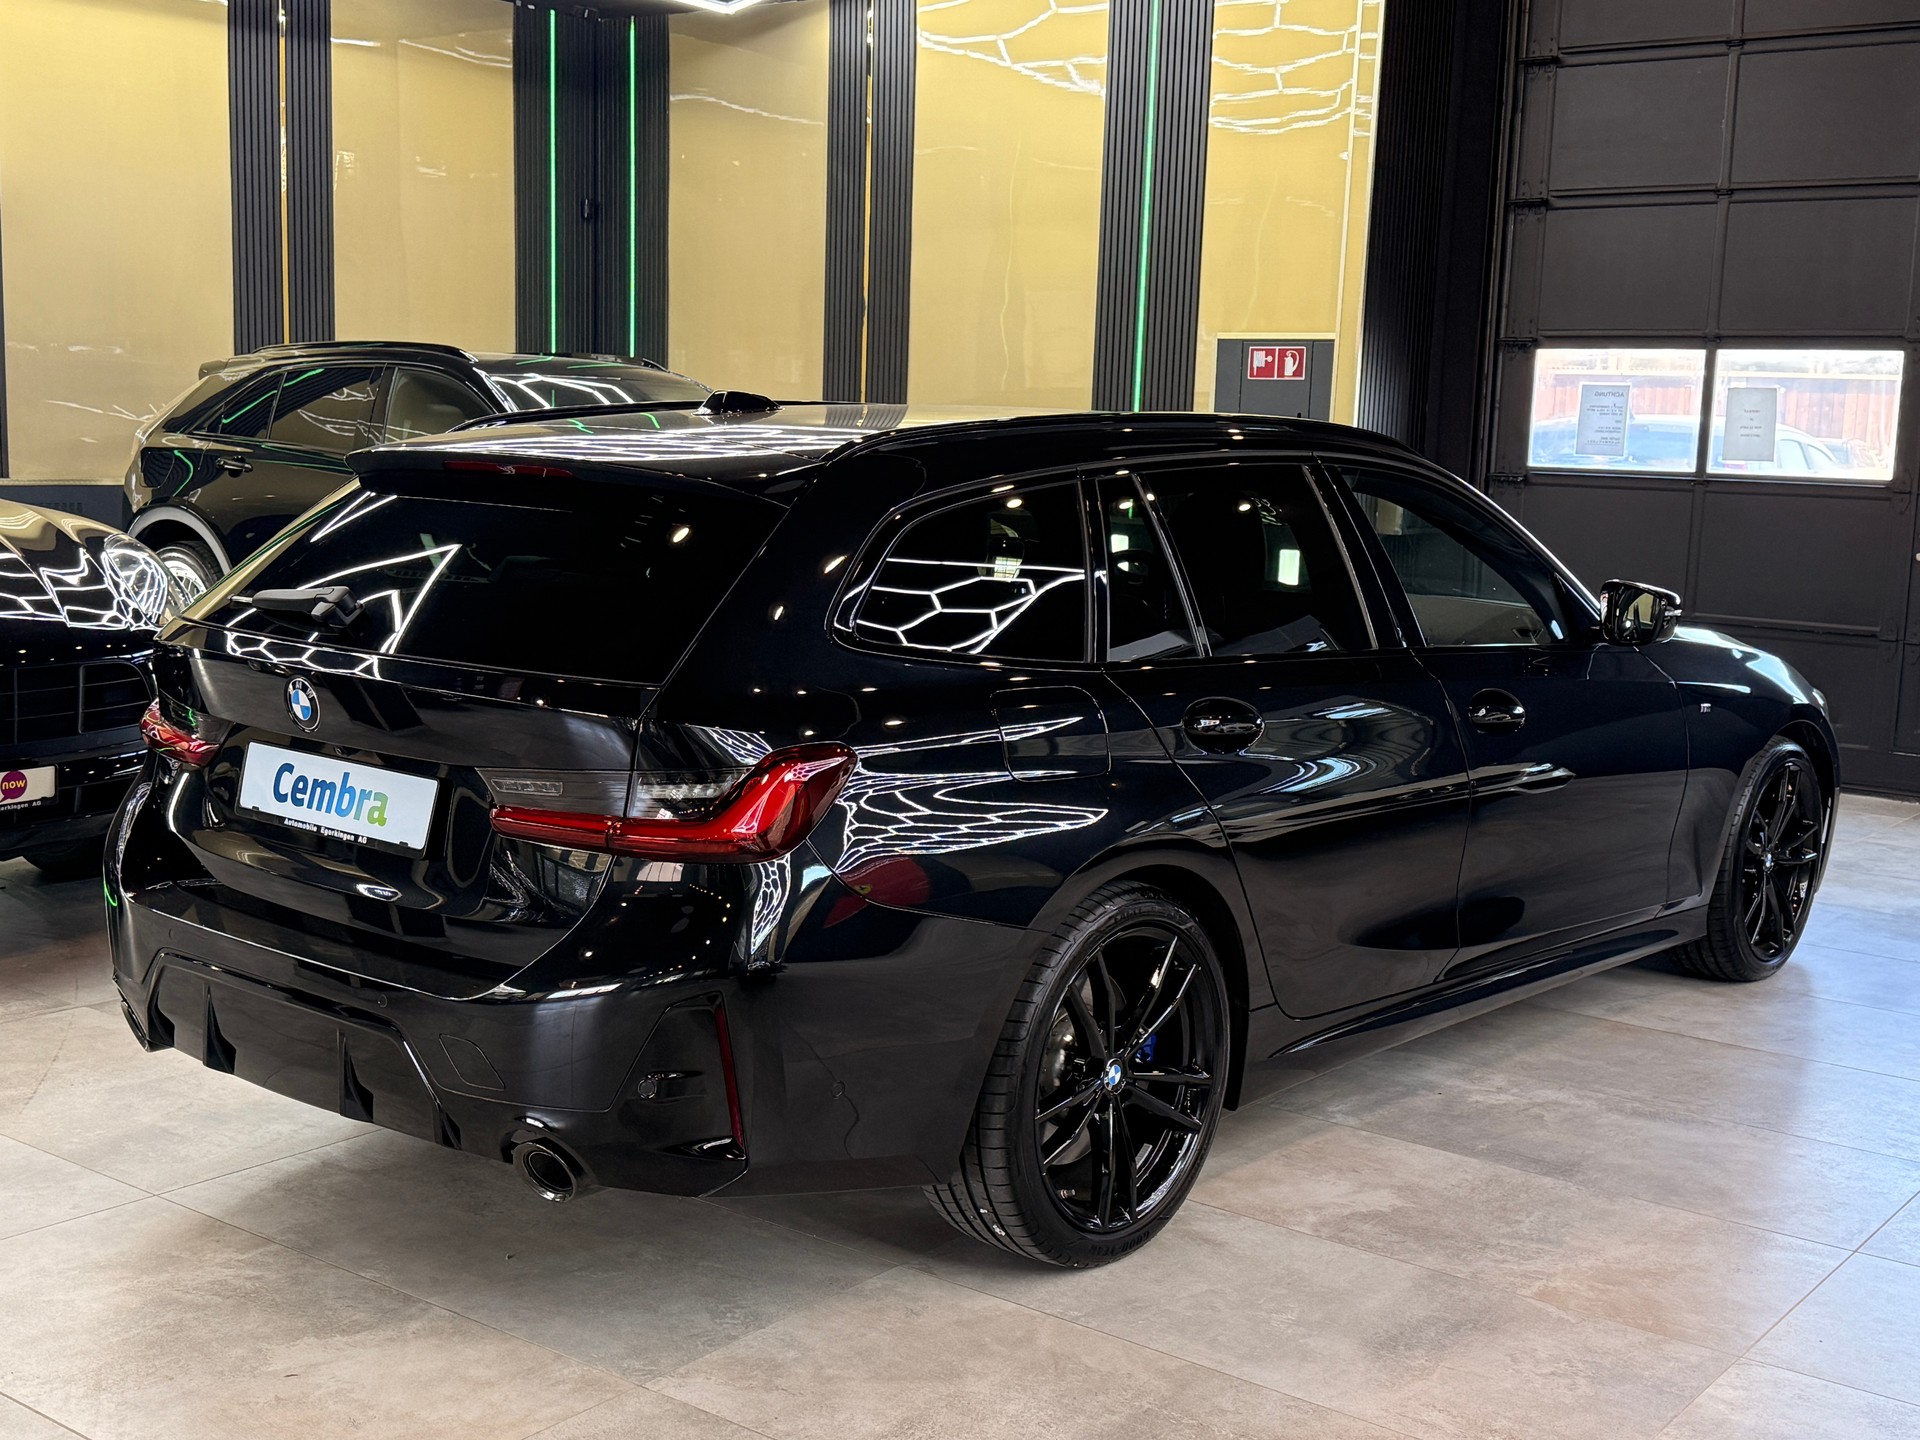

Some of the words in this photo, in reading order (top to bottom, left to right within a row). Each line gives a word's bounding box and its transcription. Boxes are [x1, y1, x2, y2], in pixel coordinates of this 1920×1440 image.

[2, 780, 26, 790] now
[273, 762, 389, 827] Cembra
[0, 803, 29, 812] erkingen
[284, 818, 318, 833] Automobile
[320, 826, 355, 842] Egerkingen
[357, 835, 368, 844] AG
